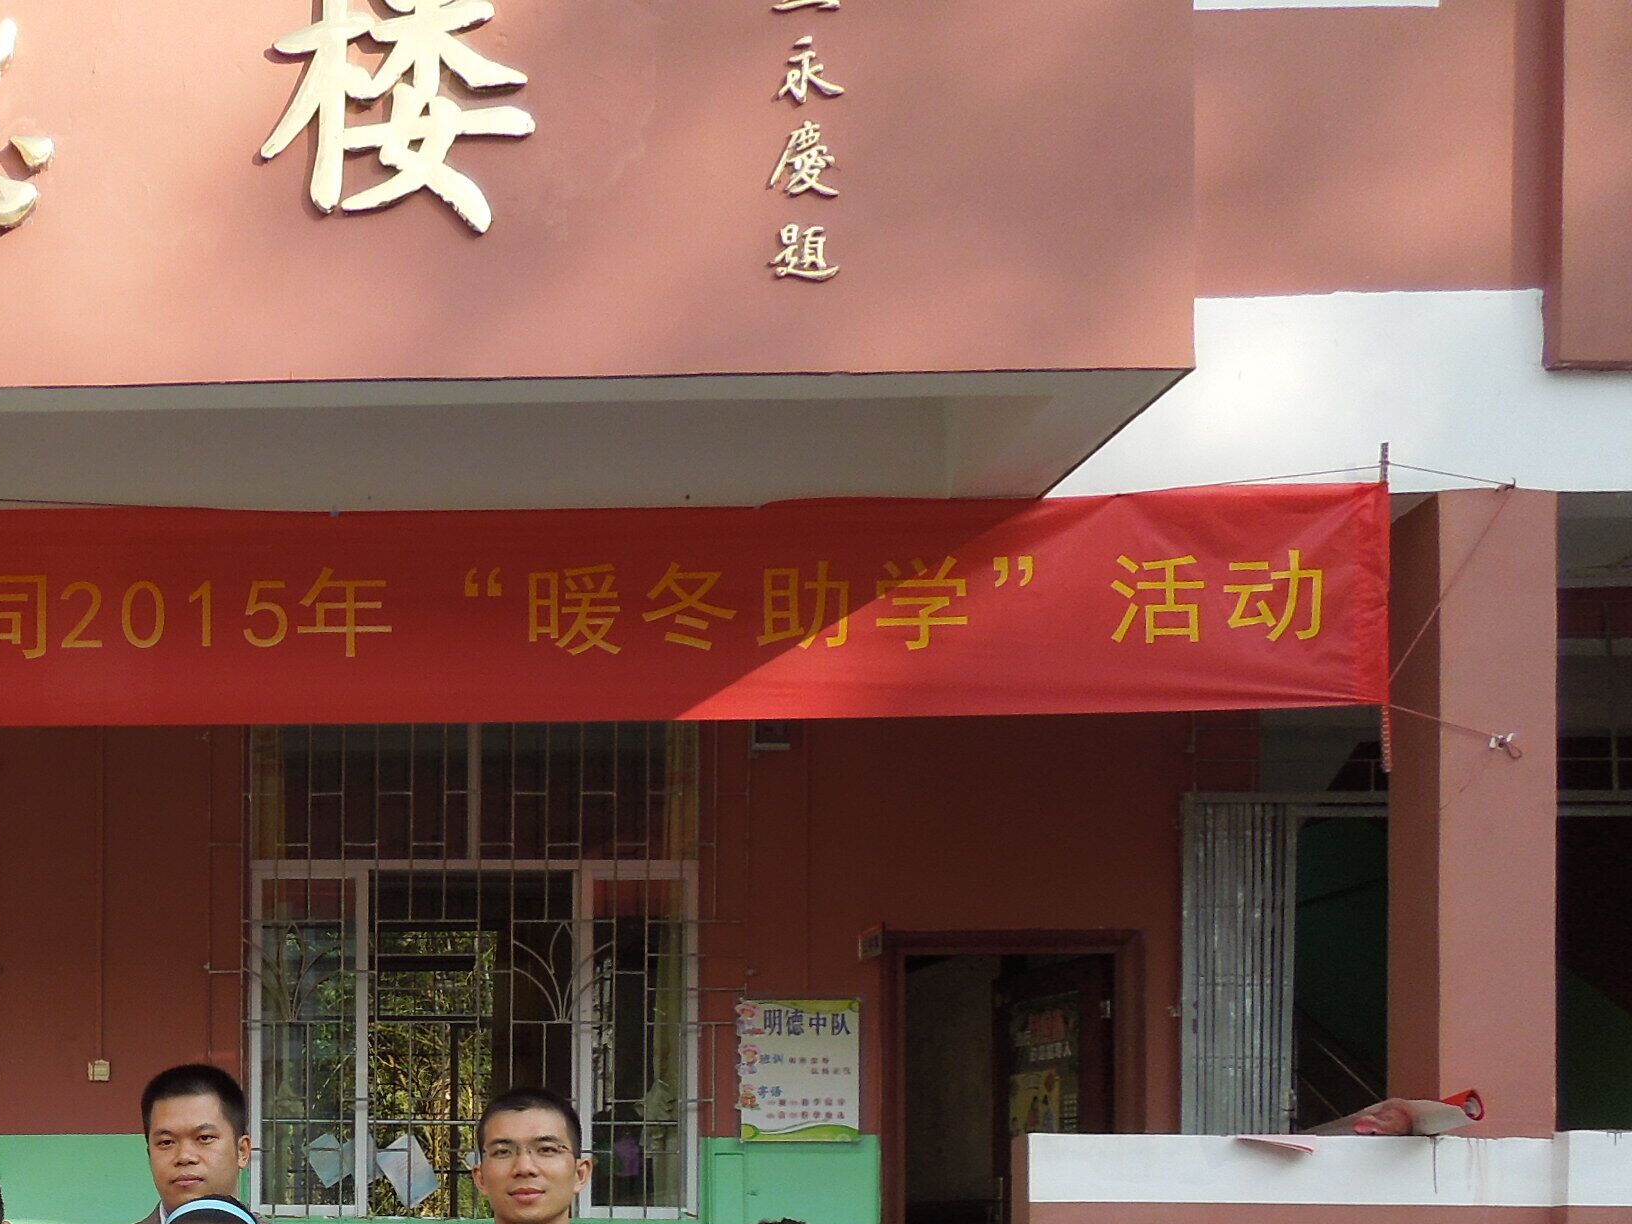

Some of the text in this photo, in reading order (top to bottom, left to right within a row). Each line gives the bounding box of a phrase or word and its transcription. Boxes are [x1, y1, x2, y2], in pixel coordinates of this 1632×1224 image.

[771, 0, 845, 281] 永慶題
[1110, 549, 1325, 644] 活动
[764, 1009, 851, 1036] 明德中队
